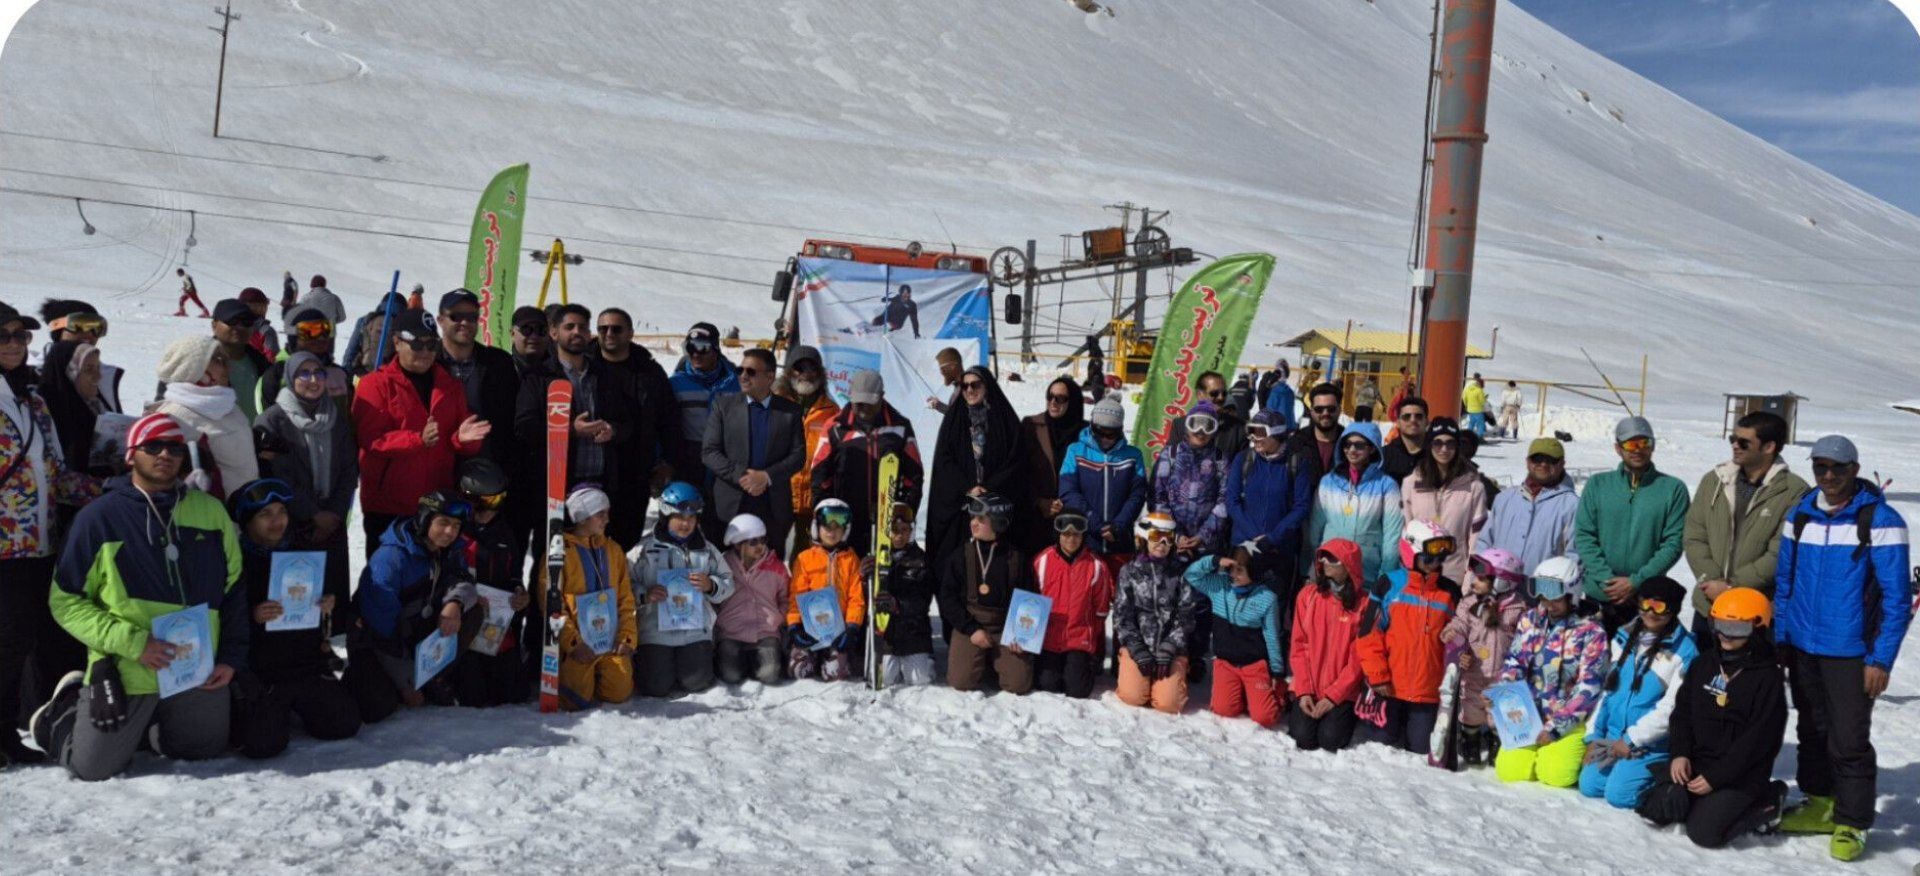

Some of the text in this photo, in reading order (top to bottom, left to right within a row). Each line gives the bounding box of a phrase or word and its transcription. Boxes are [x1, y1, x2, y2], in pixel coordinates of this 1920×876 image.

[480, 210, 502, 287] تربیت
[1182, 283, 1221, 349] تربیت
[1164, 348, 1200, 406] بدنی
[1164, 404, 1187, 418] و
